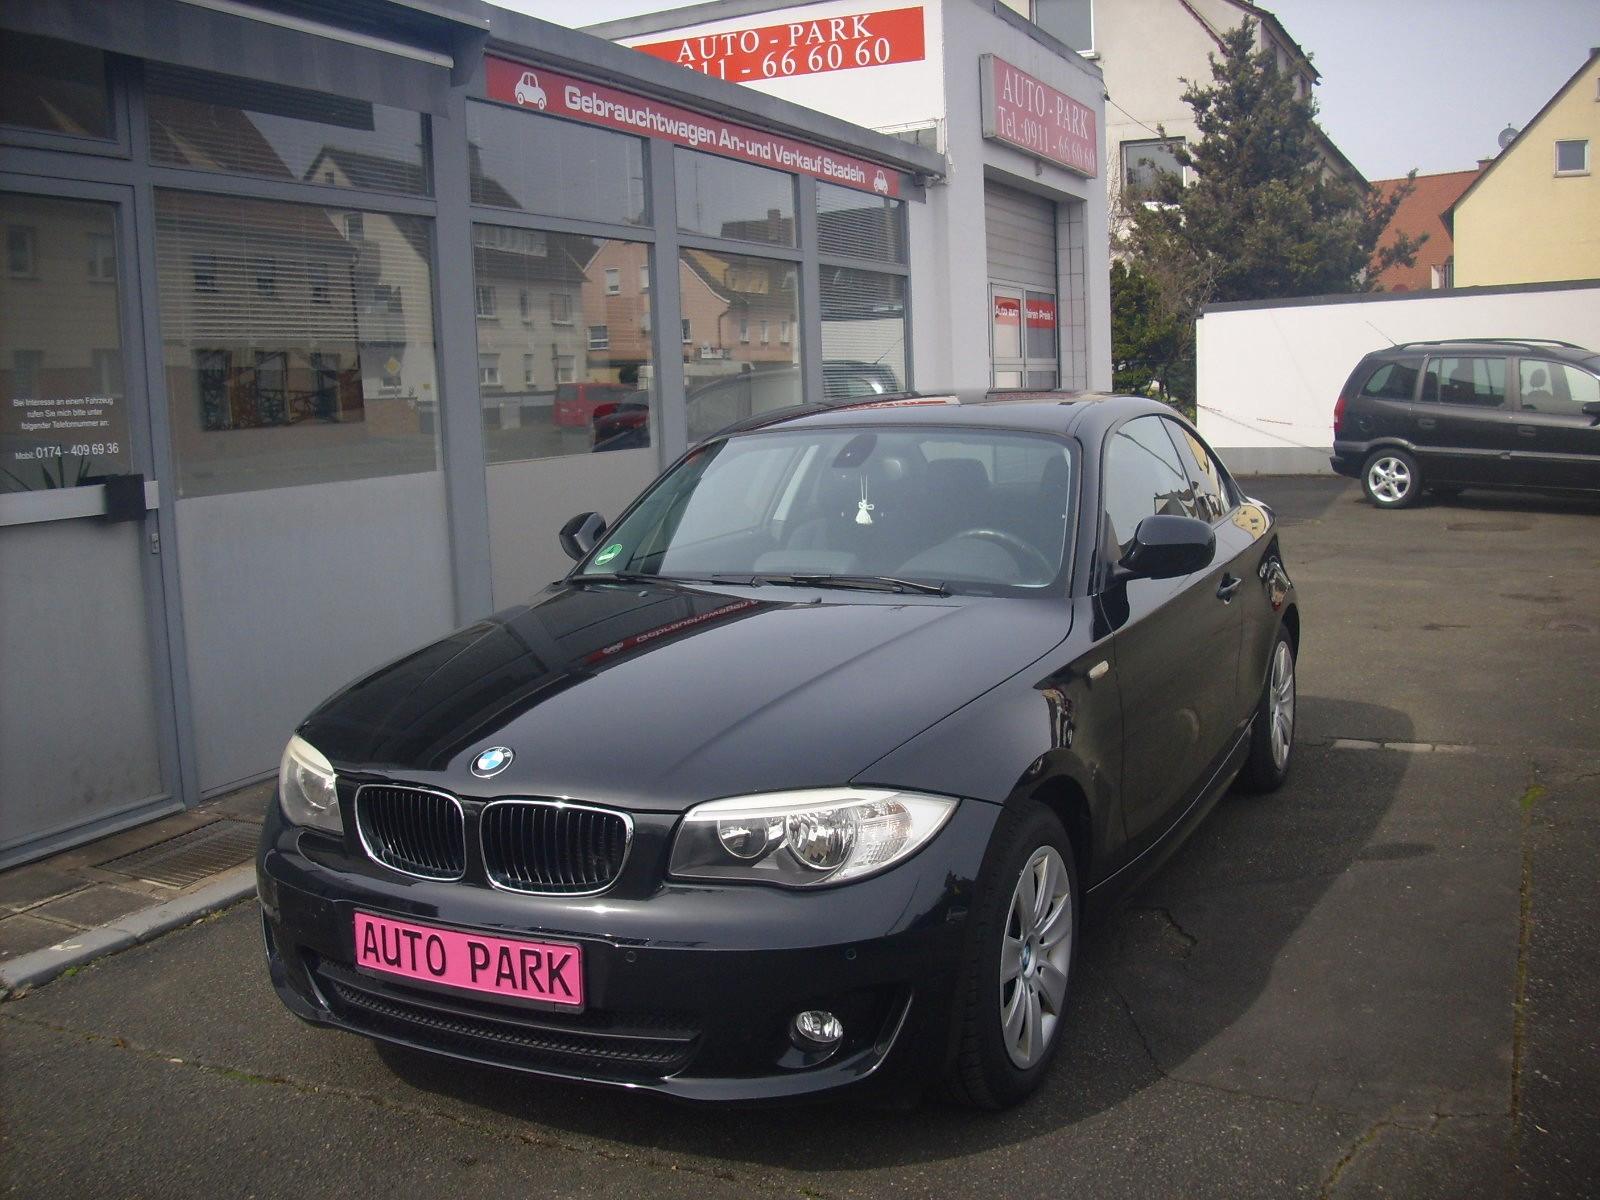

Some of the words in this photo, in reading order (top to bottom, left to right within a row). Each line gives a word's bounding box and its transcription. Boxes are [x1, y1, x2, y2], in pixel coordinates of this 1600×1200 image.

[677, 30, 760, 63] AUTO
[788, 14, 873, 47] PARK
[683, 59, 726, 80] 11
[762, 49, 796, 78] 66
[808, 44, 842, 71] 60
[855, 37, 890, 65] 60
[1003, 69, 1046, 117] AUTO
[1056, 97, 1089, 140] PARK
[564, 85, 716, 146] Gebrauchtwagen
[773, 143, 821, 173] Verkauf
[823, 157, 866, 183] Stadeln
[26, 398, 55, 407] Interesse
[85, 396, 114, 407] Fahrzeug
[56, 409, 72, 418] mich
[73, 408, 87, 417] bitte
[21, 420, 52, 431] folgender
[36, 445, 62, 459] 0174
[70, 444, 90, 457] 409
[91, 443, 105, 455] 69
[106, 442, 119, 454] 36
[362, 921, 447, 977] AUTO
[467, 941, 573, 997] PARK
